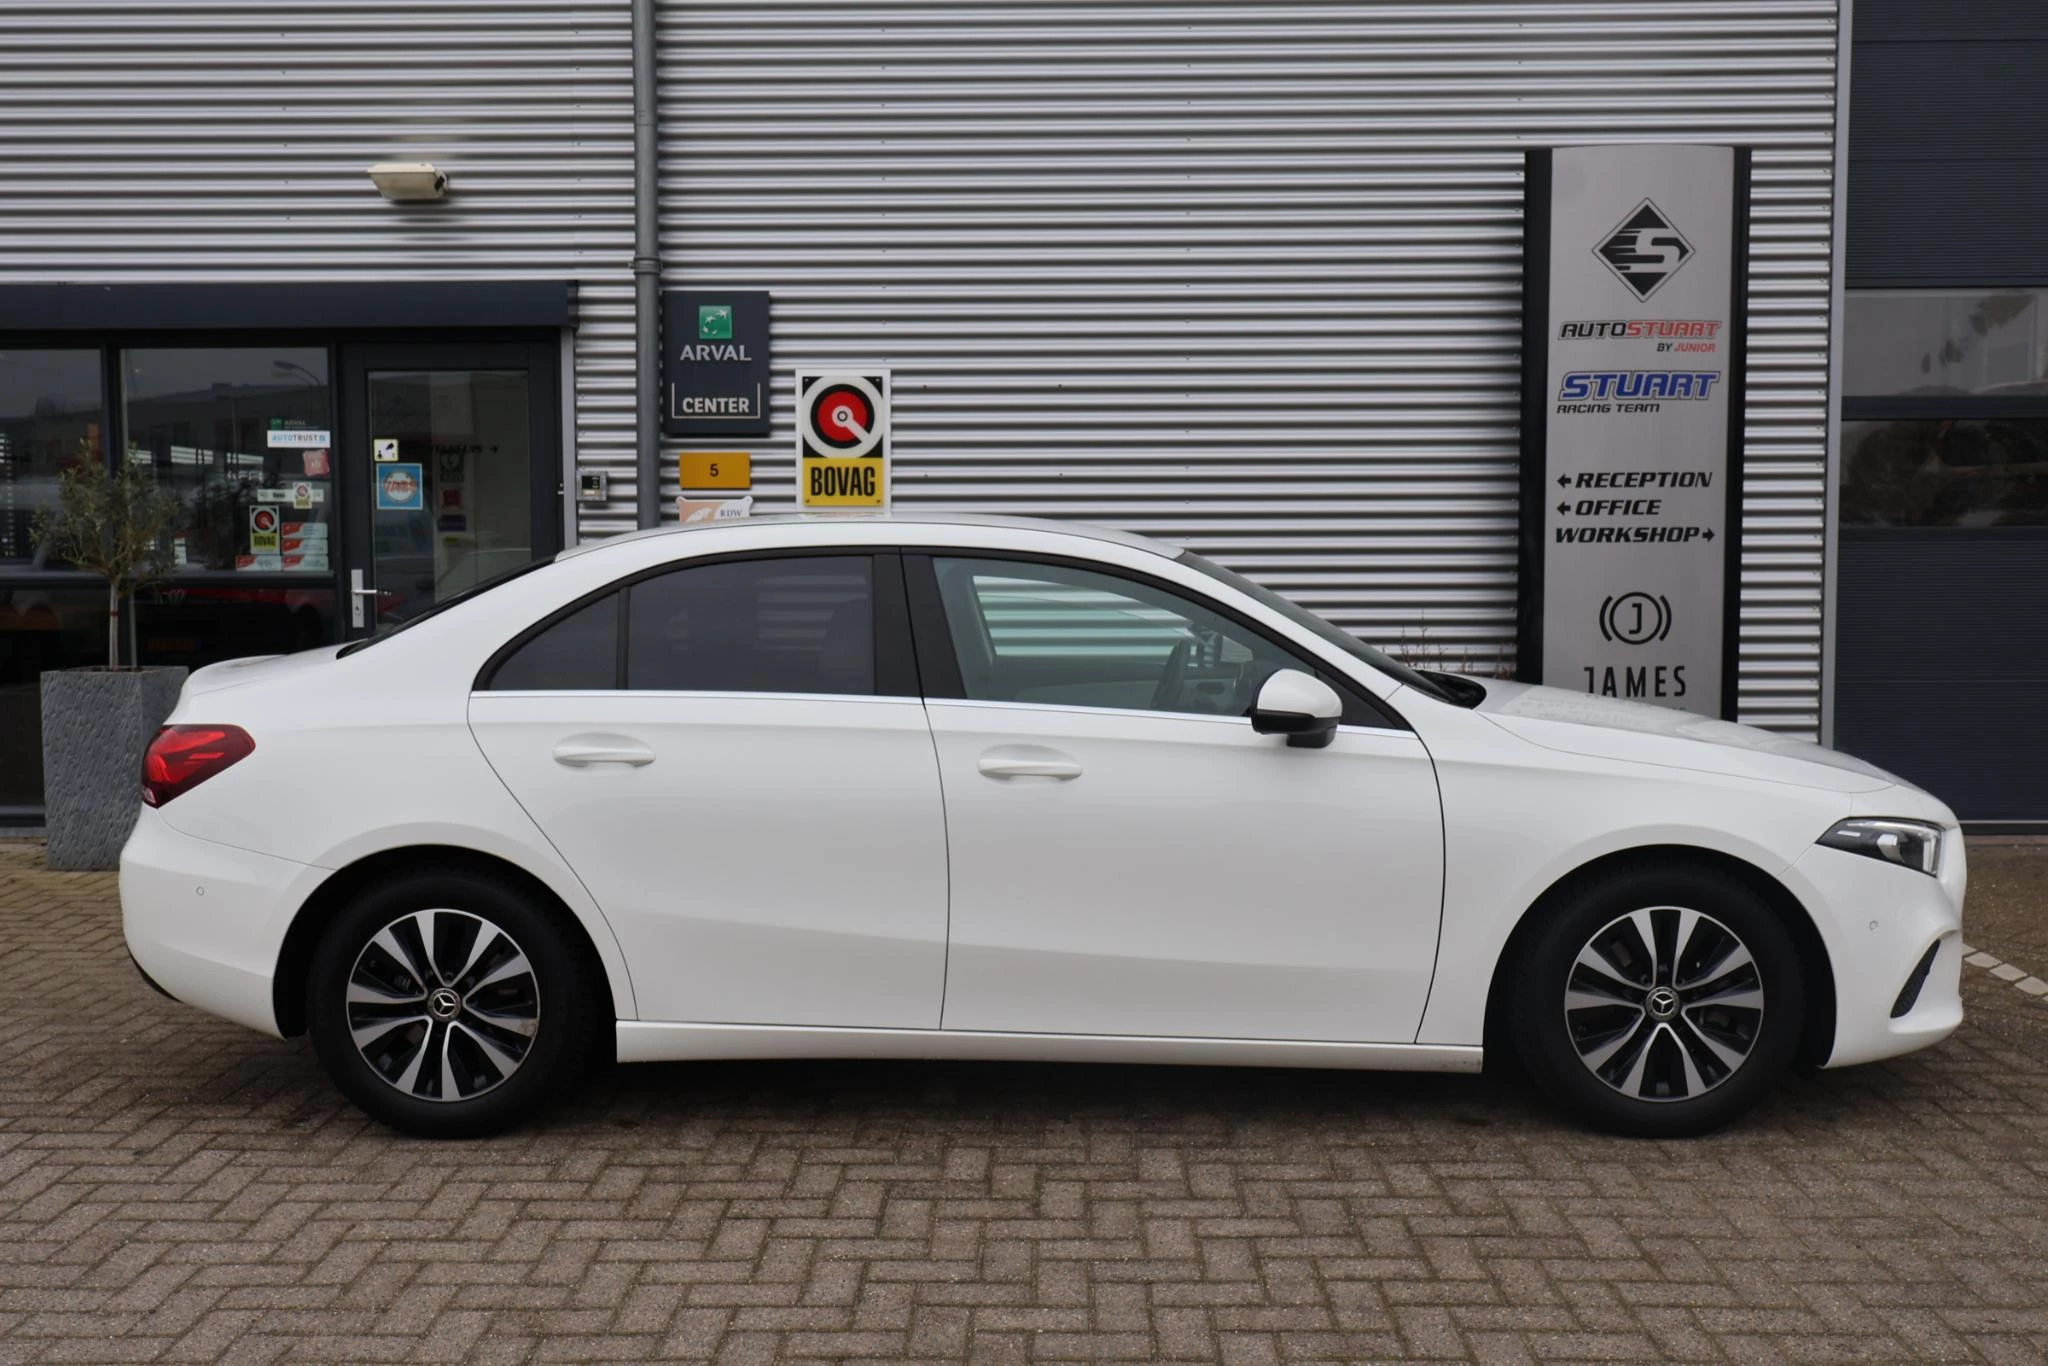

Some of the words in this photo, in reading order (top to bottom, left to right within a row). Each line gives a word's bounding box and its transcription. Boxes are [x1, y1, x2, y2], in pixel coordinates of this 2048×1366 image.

[1558, 320, 1721, 339] AUTOSTUART
[680, 345, 752, 361] ARVAL
[1656, 343, 1673, 352] BY
[1674, 343, 1715, 353] JUNIOR
[1559, 372, 1720, 400] STUART
[682, 397, 750, 414] CENTER
[1557, 403, 1611, 414] RACING
[1616, 403, 1660, 413] TEAM
[271, 434, 318, 442] AUTOTRUST
[709, 463, 719, 477] 5
[810, 466, 876, 496] BOVAG
[1575, 472, 1712, 488] RECEPTION
[720, 508, 743, 518] RDW
[1575, 500, 1662, 515] OFFICE
[1555, 527, 1699, 543] WORKSHOP
[1584, 665, 1686, 698] JAMES
